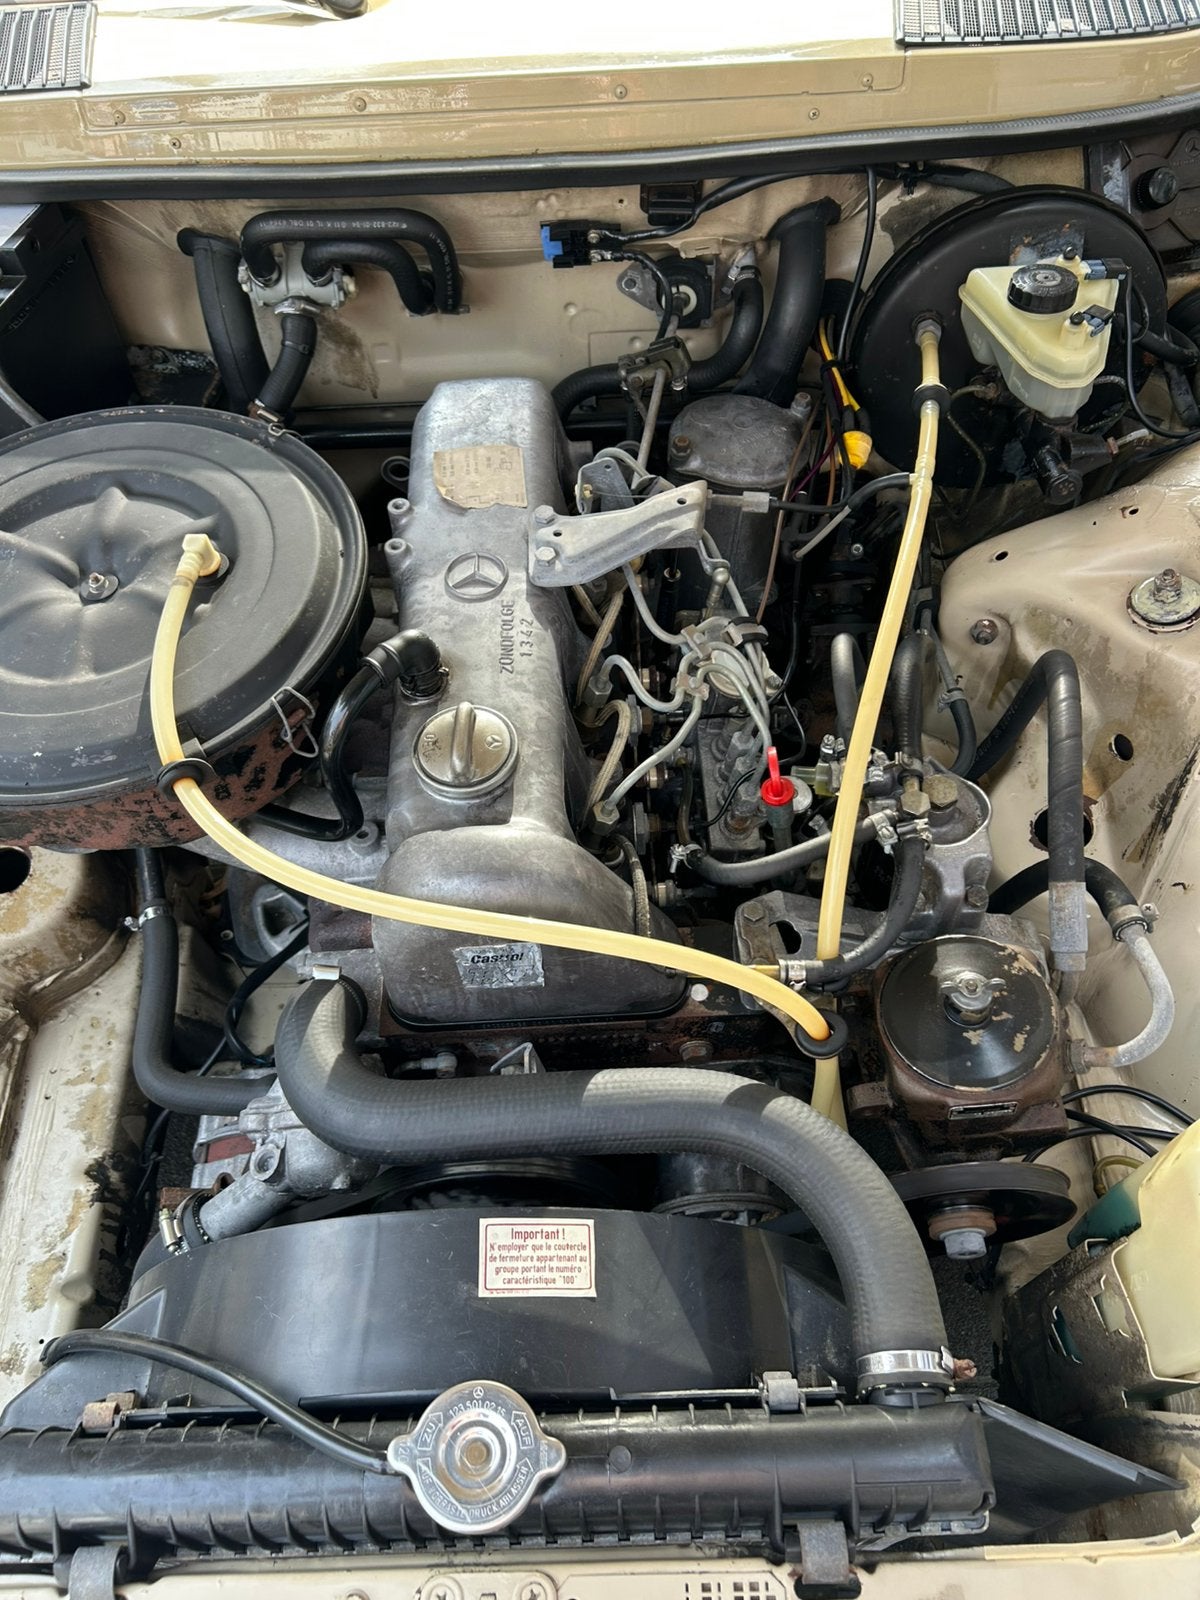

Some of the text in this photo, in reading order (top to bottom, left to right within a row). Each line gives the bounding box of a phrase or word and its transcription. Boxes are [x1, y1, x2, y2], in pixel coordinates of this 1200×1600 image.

[511, 1228, 560, 1242] Important
[531, 1244, 544, 1253] que
[545, 1242, 552, 1251] le
[488, 1254, 588, 1264] de fermeture appartenant au
[494, 1265, 582, 1276] groupe portant le numéro
[502, 1275, 557, 1286] caractéristique
[422, 1422, 436, 1442] ZU
[514, 1418, 531, 1446] AUF
[469, 1503, 499, 1518] DRUCK
